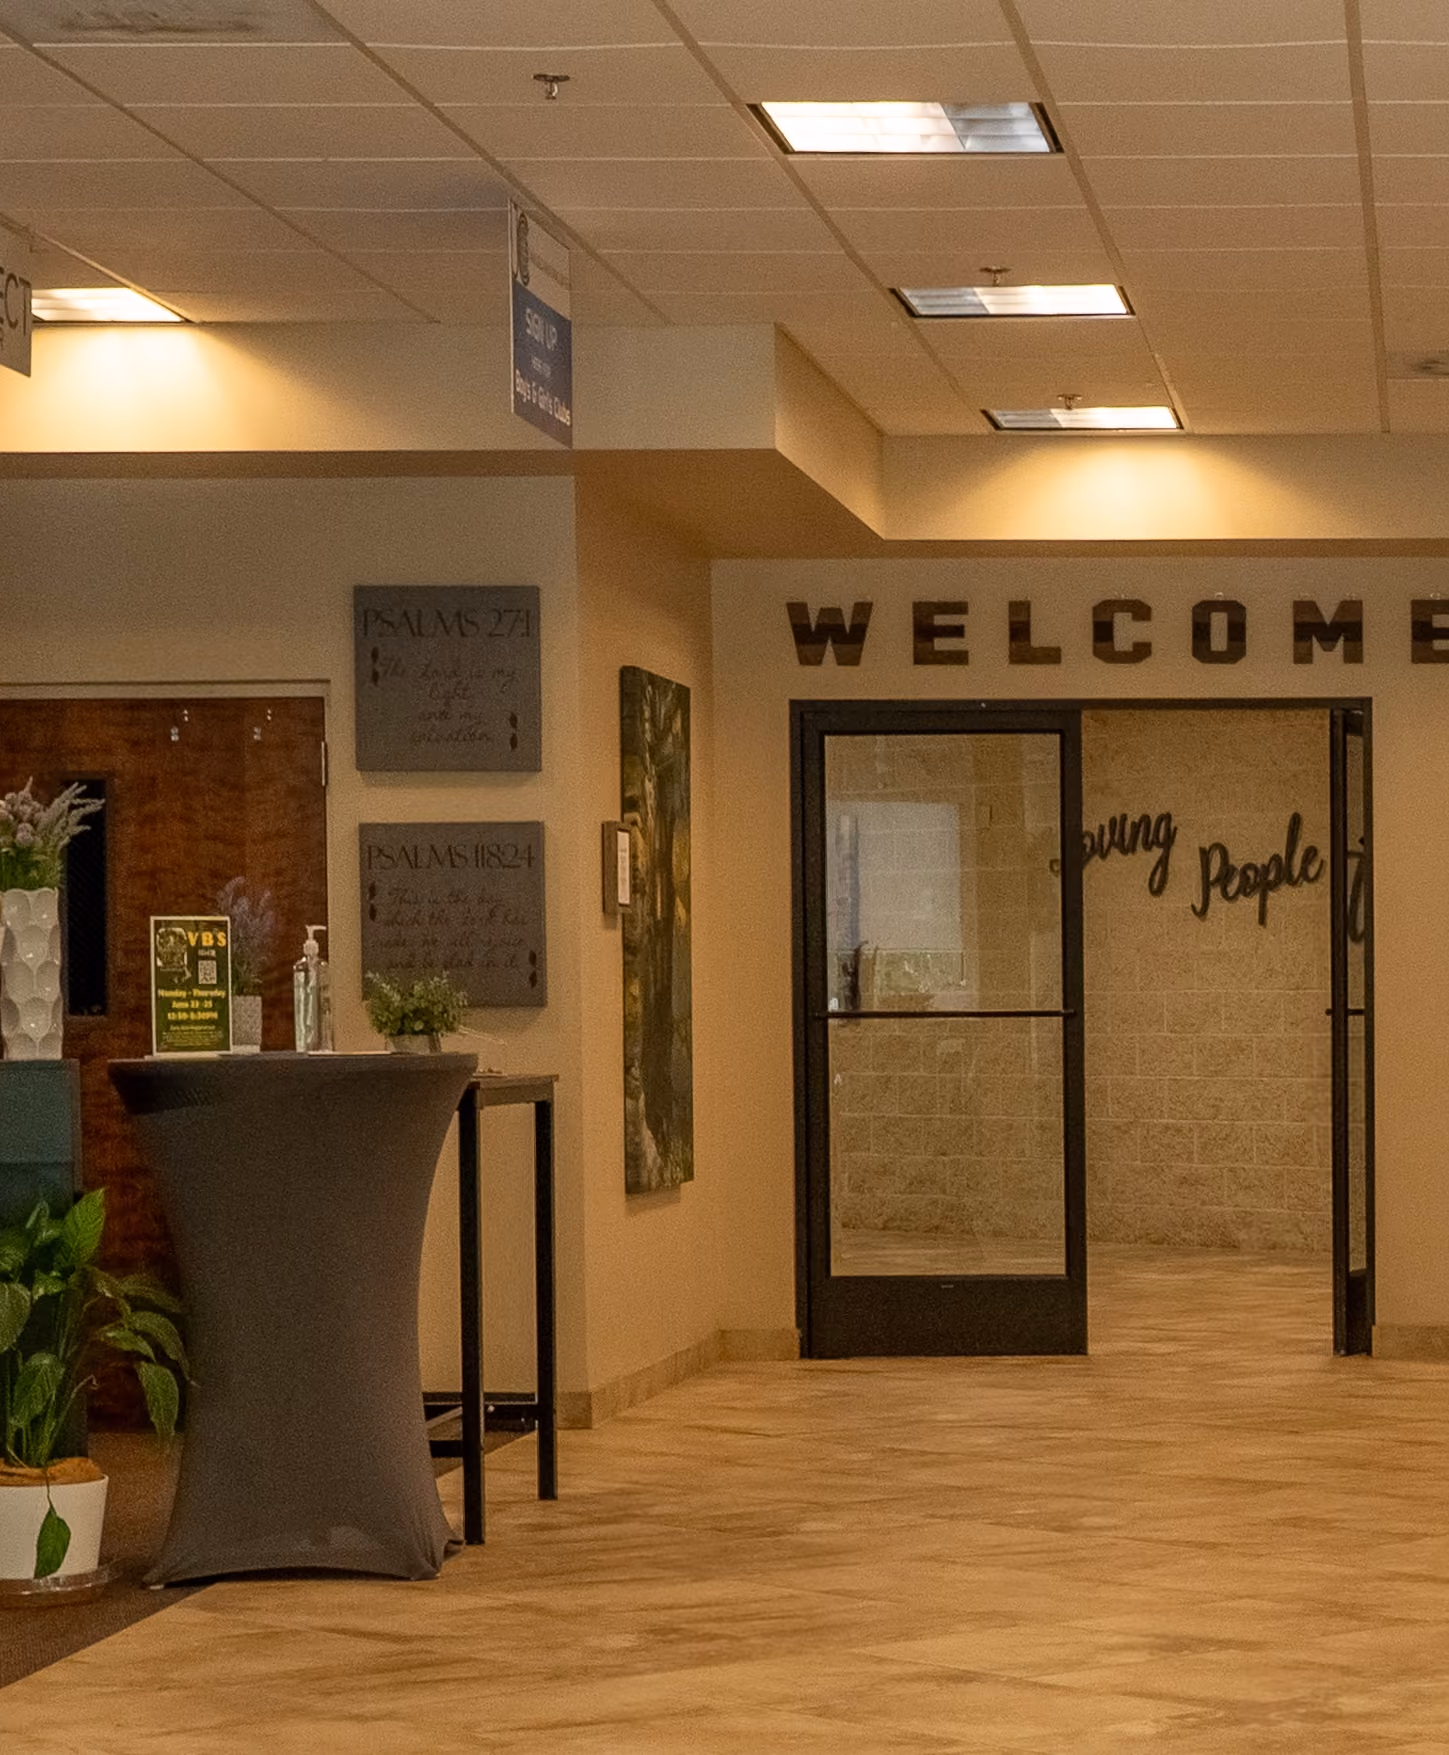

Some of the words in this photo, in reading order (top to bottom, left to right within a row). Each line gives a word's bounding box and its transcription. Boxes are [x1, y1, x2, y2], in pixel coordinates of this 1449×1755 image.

[362, 608, 481, 638] PSALMS
[367, 843, 470, 870] PSALMS
[1191, 811, 1324, 928] People
